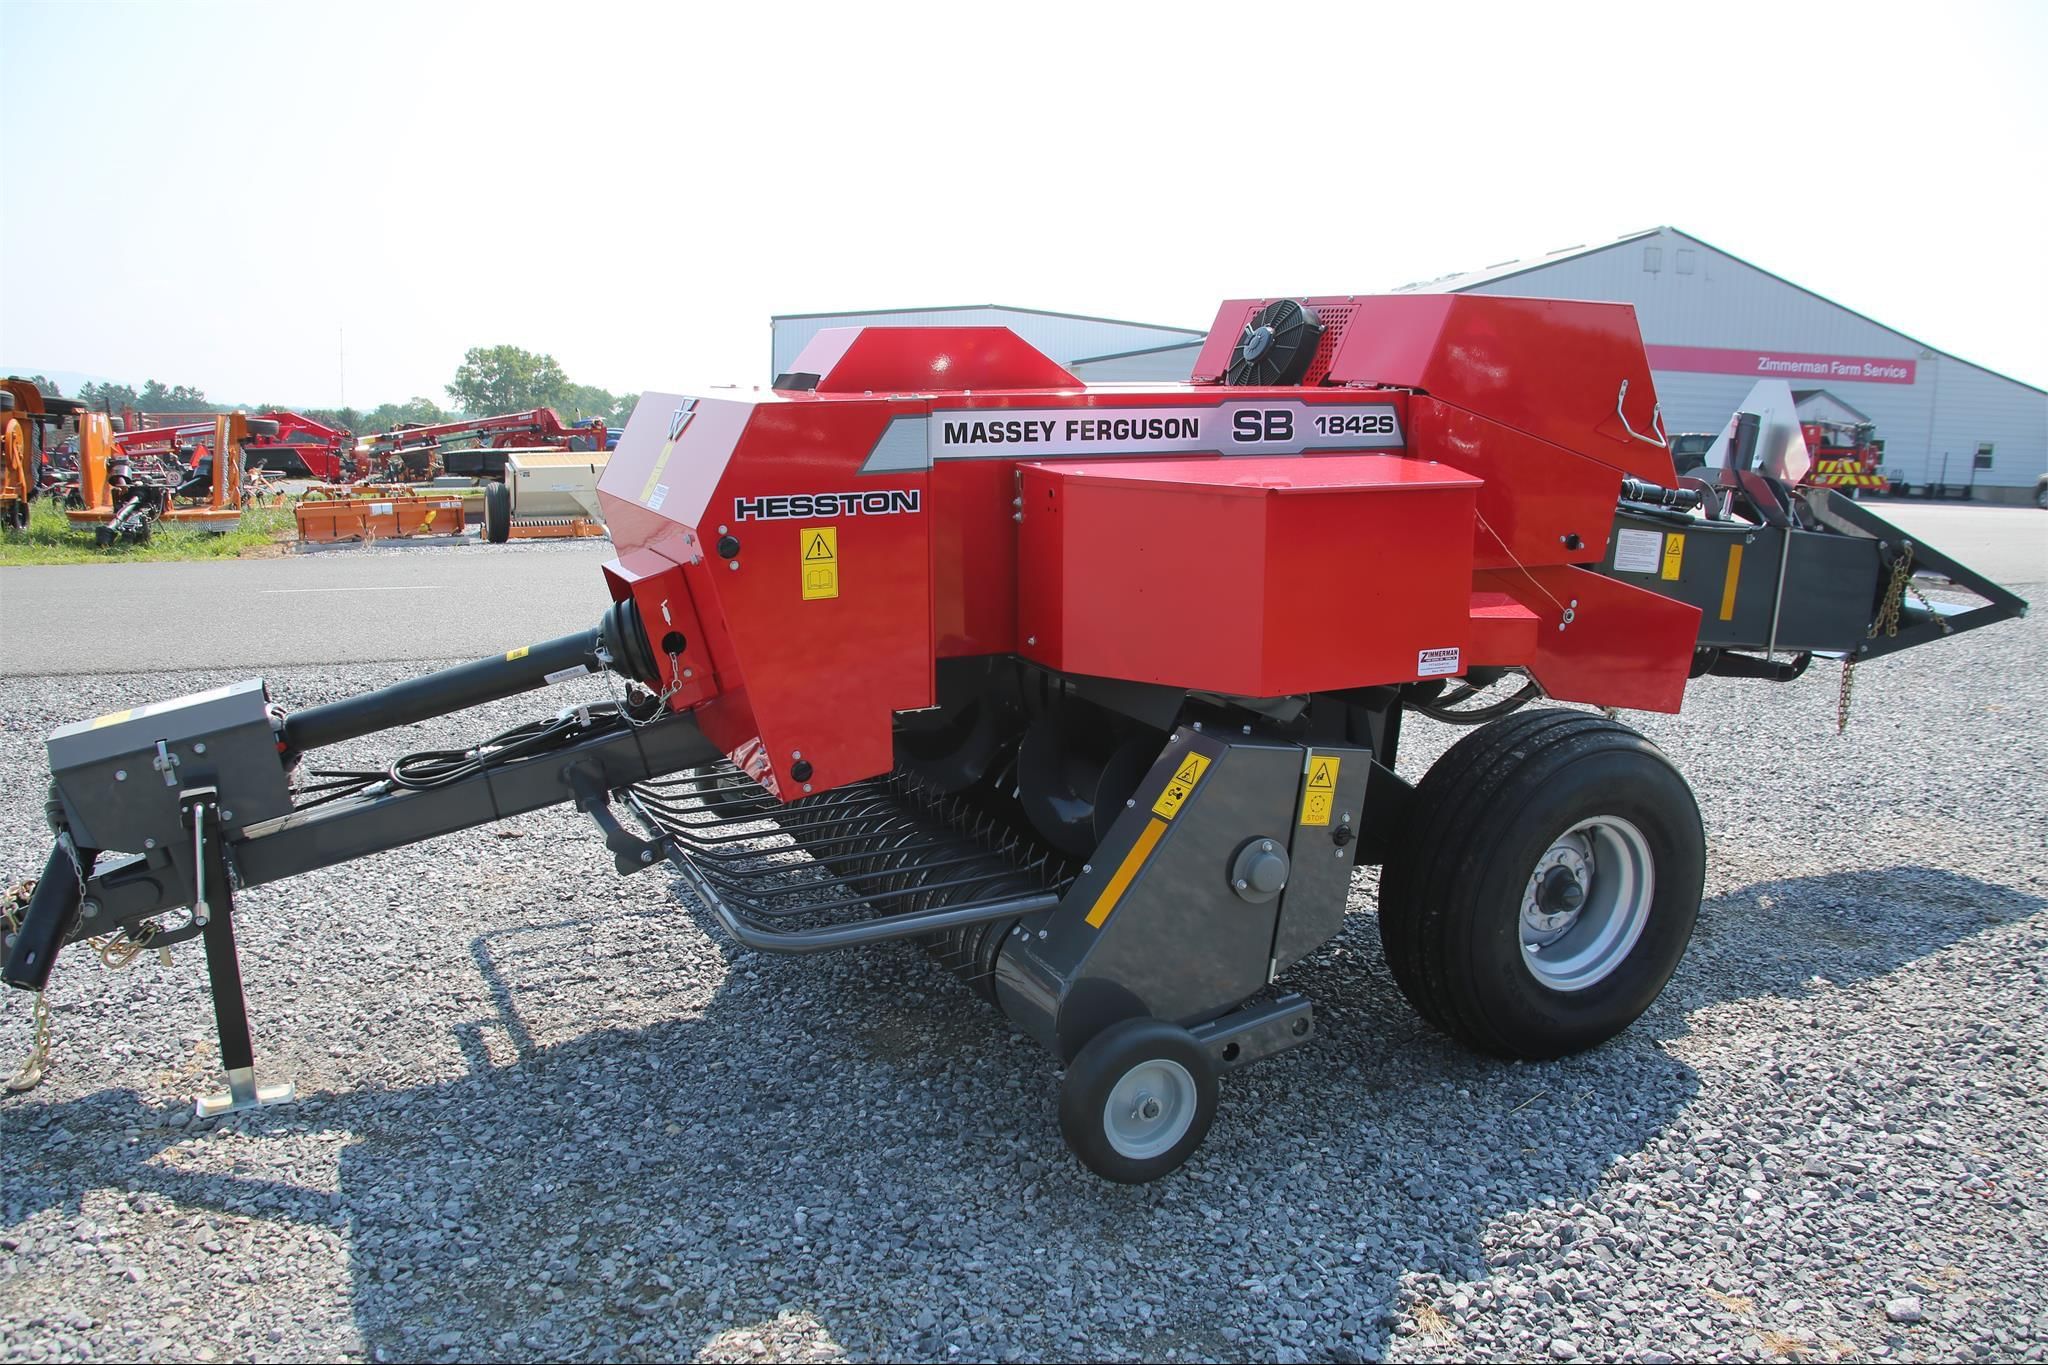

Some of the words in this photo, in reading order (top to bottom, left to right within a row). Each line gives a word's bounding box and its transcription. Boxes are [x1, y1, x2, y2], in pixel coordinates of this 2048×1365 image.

[1757, 357, 1828, 374] Zimmerman
[1831, 361, 1861, 376] Farm
[1863, 363, 1907, 379] Service
[943, 420, 1056, 444] MASSEY
[1065, 418, 1199, 441] FERGUSON
[1232, 409, 1294, 442] SB
[1314, 415, 1394, 435] 1842S
[734, 490, 920, 521] HESSTON
[1420, 649, 1458, 663] ZIMMERMAN
[1305, 814, 1325, 822] STOP
